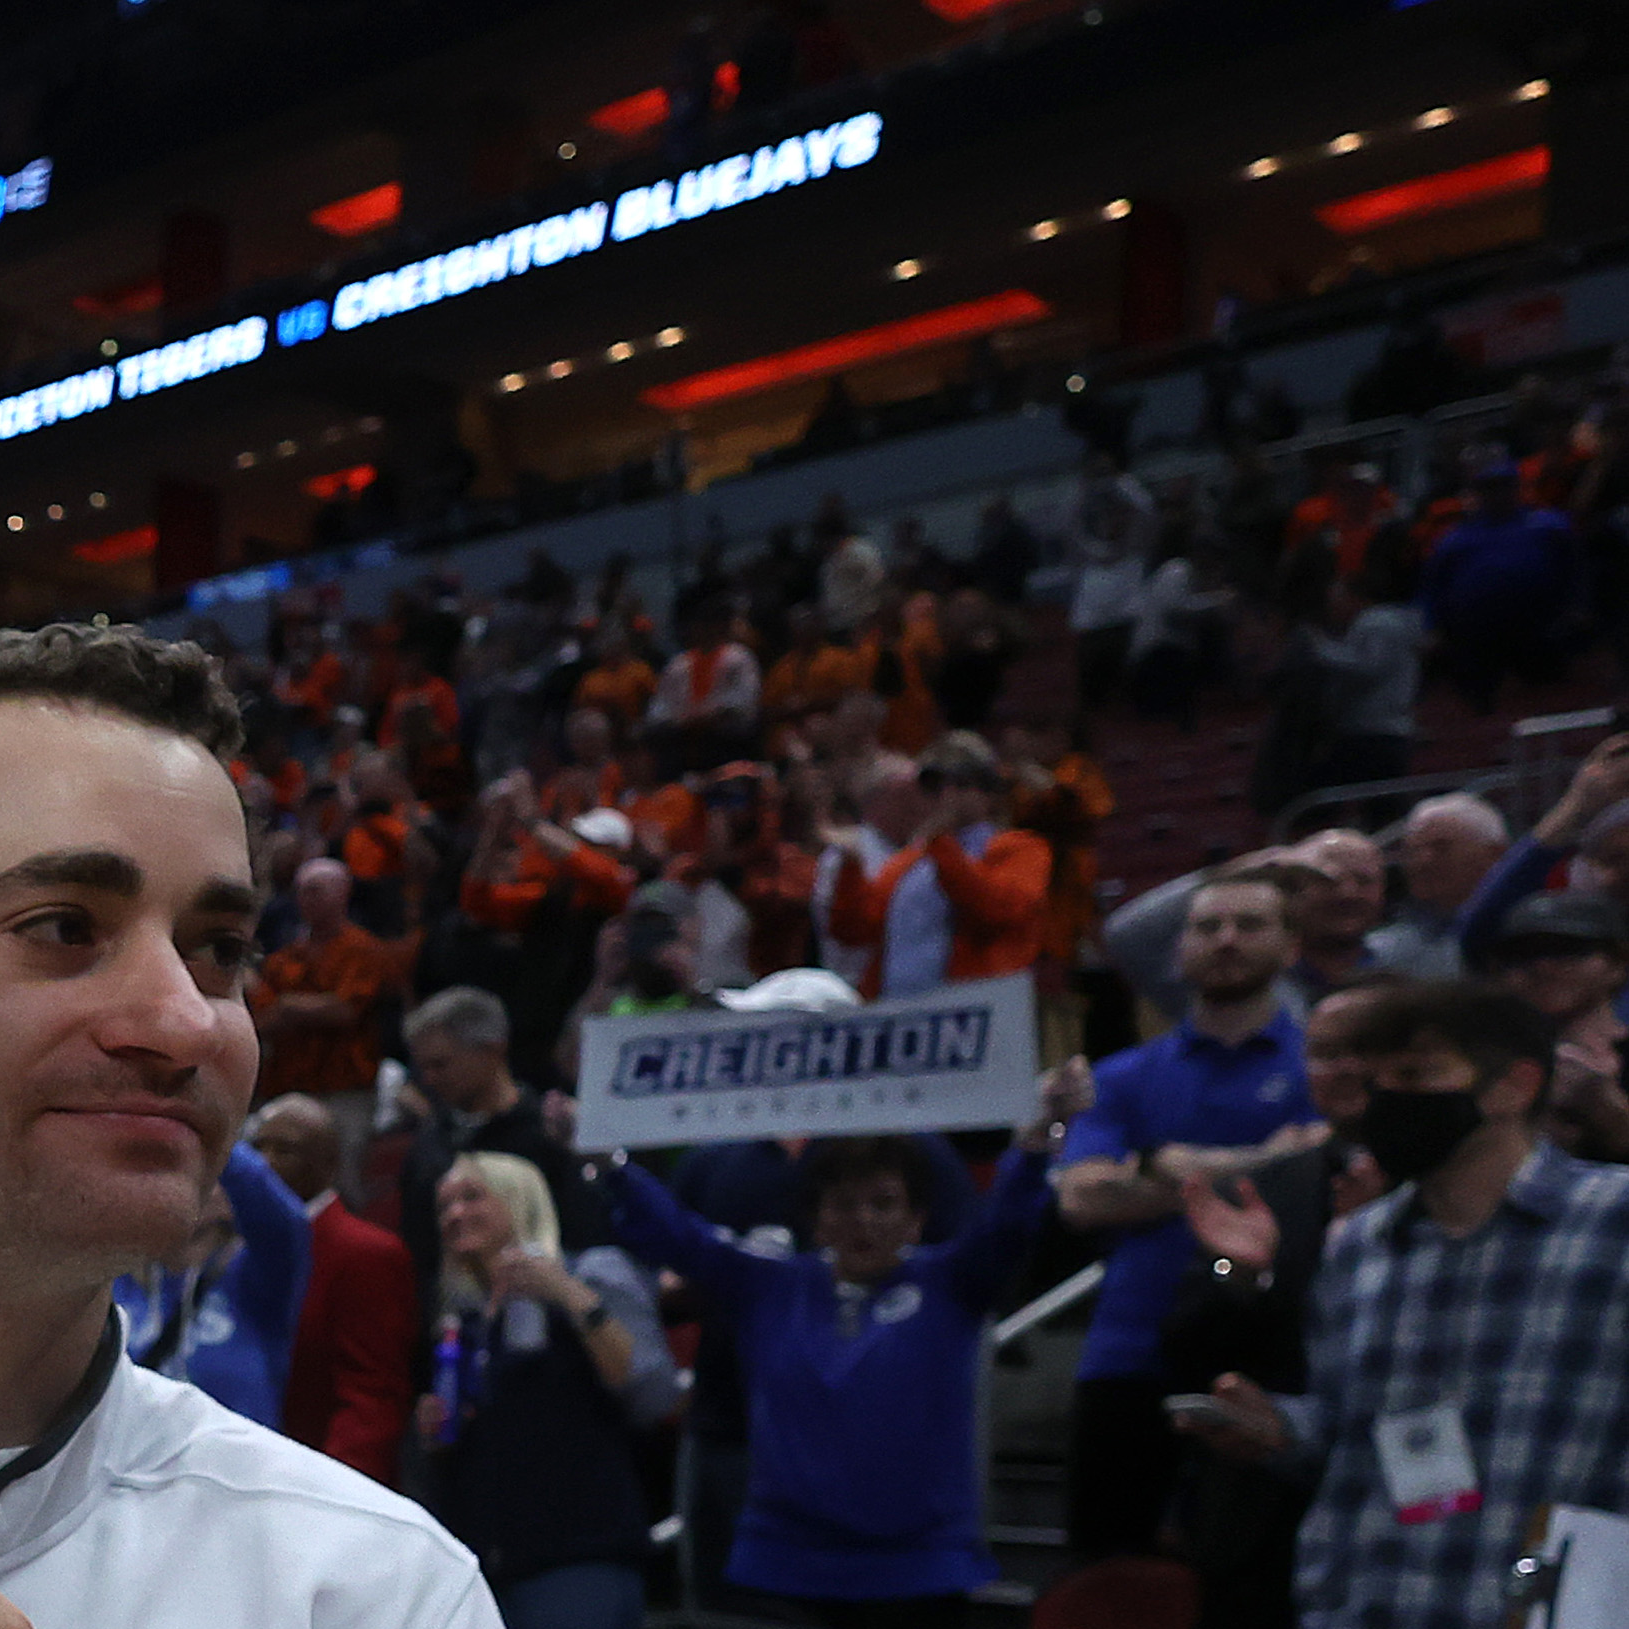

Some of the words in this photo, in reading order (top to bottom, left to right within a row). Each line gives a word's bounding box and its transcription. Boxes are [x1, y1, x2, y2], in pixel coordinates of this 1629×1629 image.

[330, 200, 609, 331] CREIGHTON
[610, 111, 884, 242] BLUEJAYS
[612, 1005, 990, 1096] CREIGHTON
